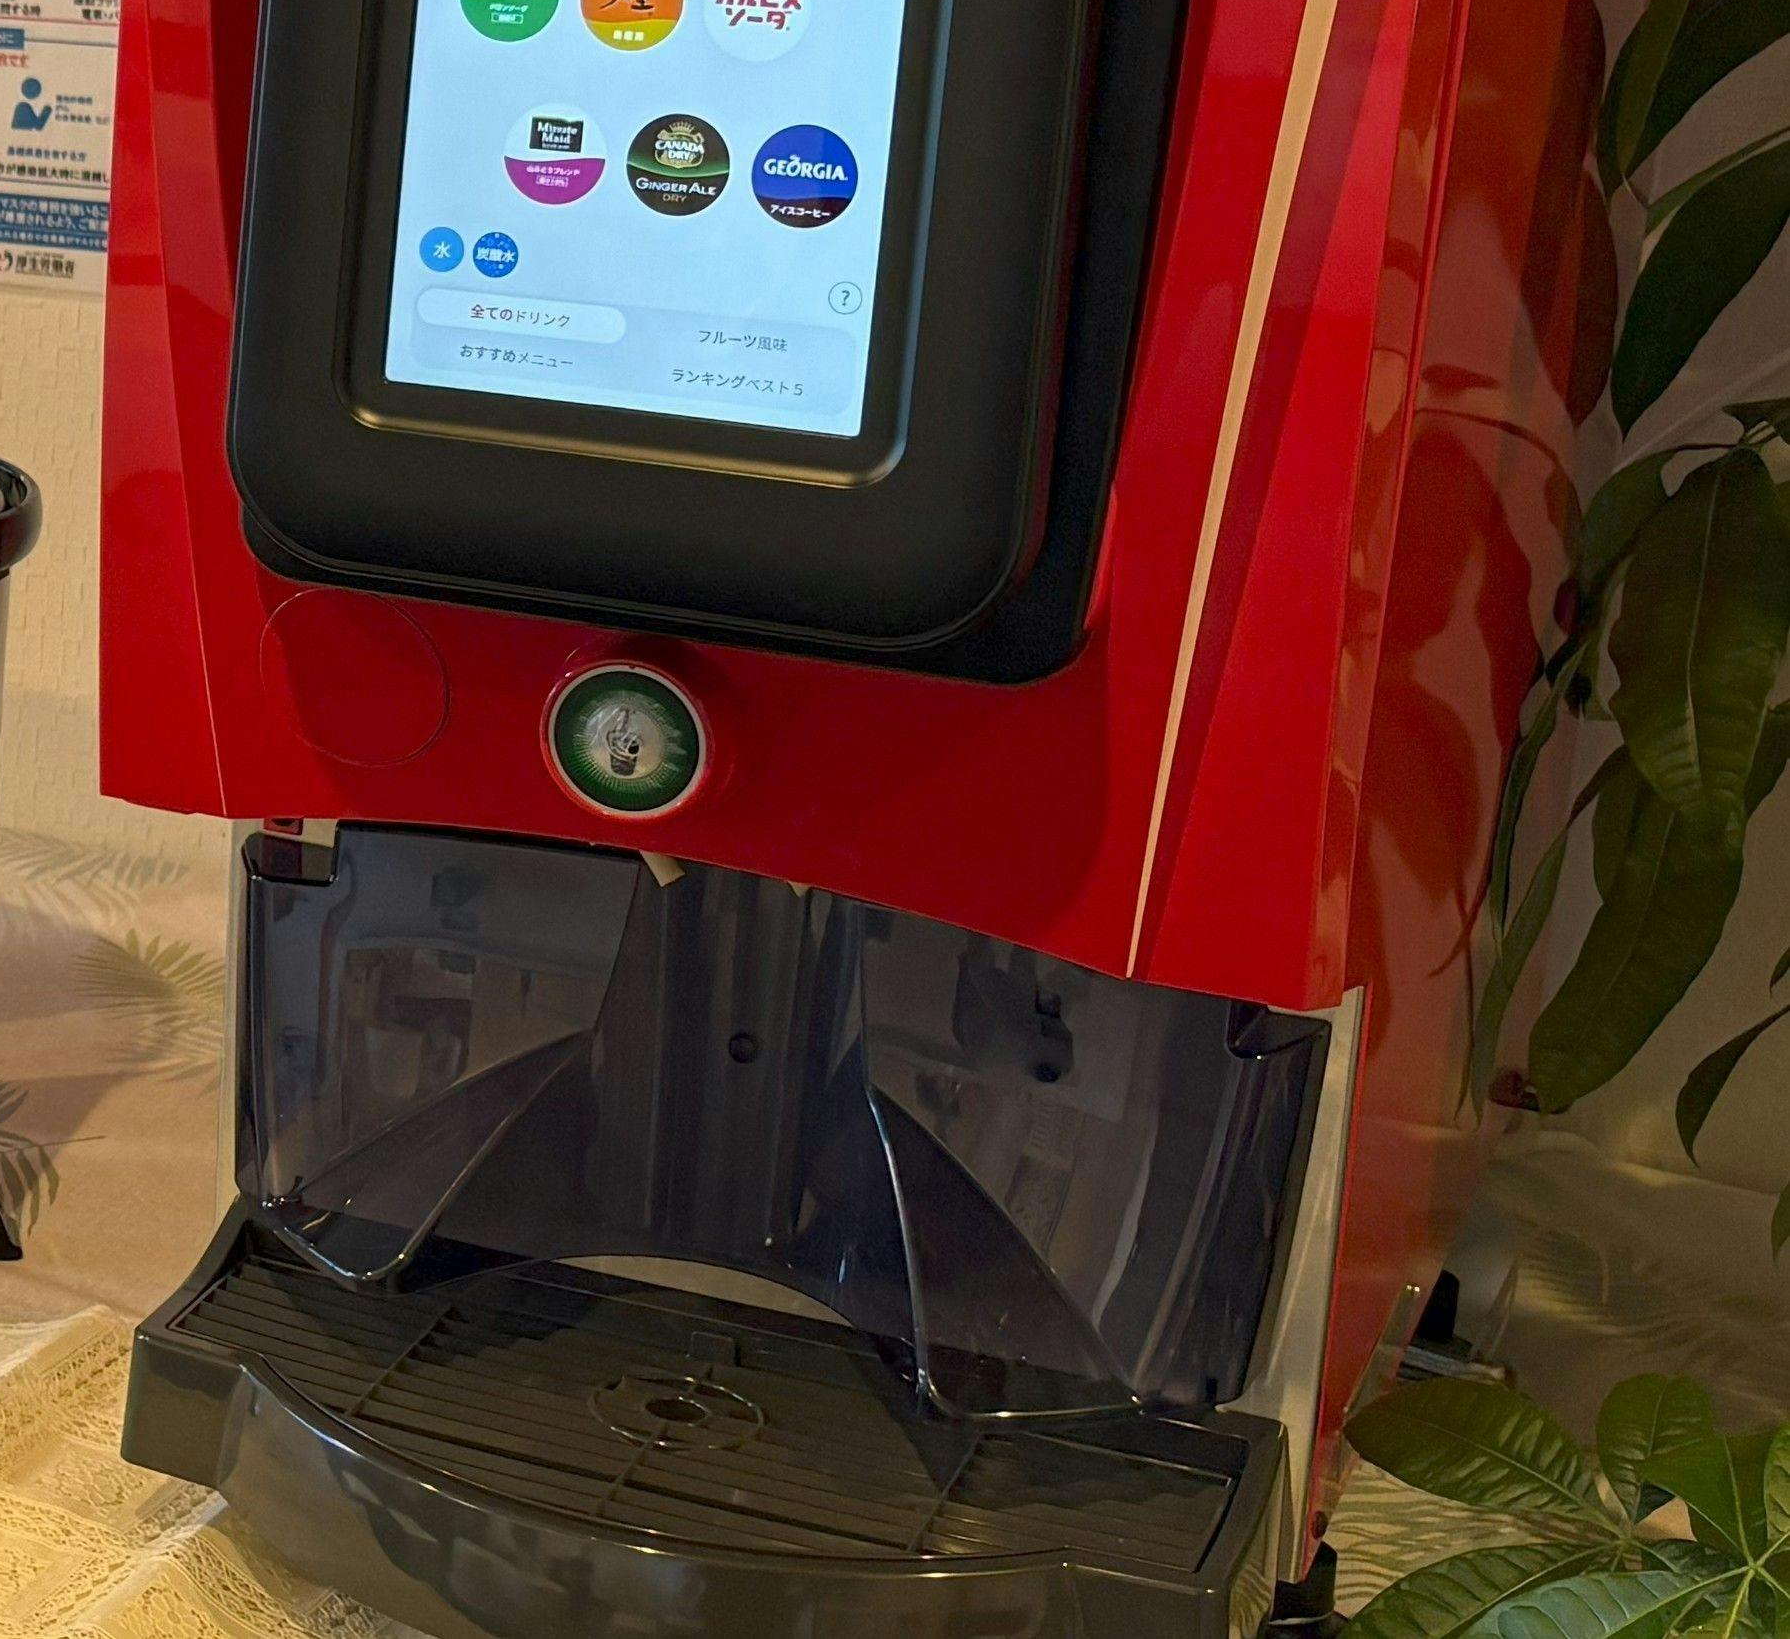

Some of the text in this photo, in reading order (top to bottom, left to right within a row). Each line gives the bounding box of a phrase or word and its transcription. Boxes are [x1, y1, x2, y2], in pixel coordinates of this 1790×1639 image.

[725, 7, 791, 30] ソーダ
[542, 133, 571, 145] Maid
[655, 139, 704, 153] CANADA
[668, 149, 693, 161] DRY
[763, 154, 847, 181] GEORGIA
[635, 177, 717, 196] GINGER ALE
[663, 191, 687, 203] DRY
[770, 204, 831, 218] アイスコーヒー
[433, 242, 451, 259] 水
[475, 246, 516, 264] 炭酸水
[470, 303, 571, 328] 全てのドリンク
[698, 328, 788, 353] フルーツ風味
[460, 343, 574, 368] おすすめメニュー
[671, 367, 804, 397] ランキングベスト5
